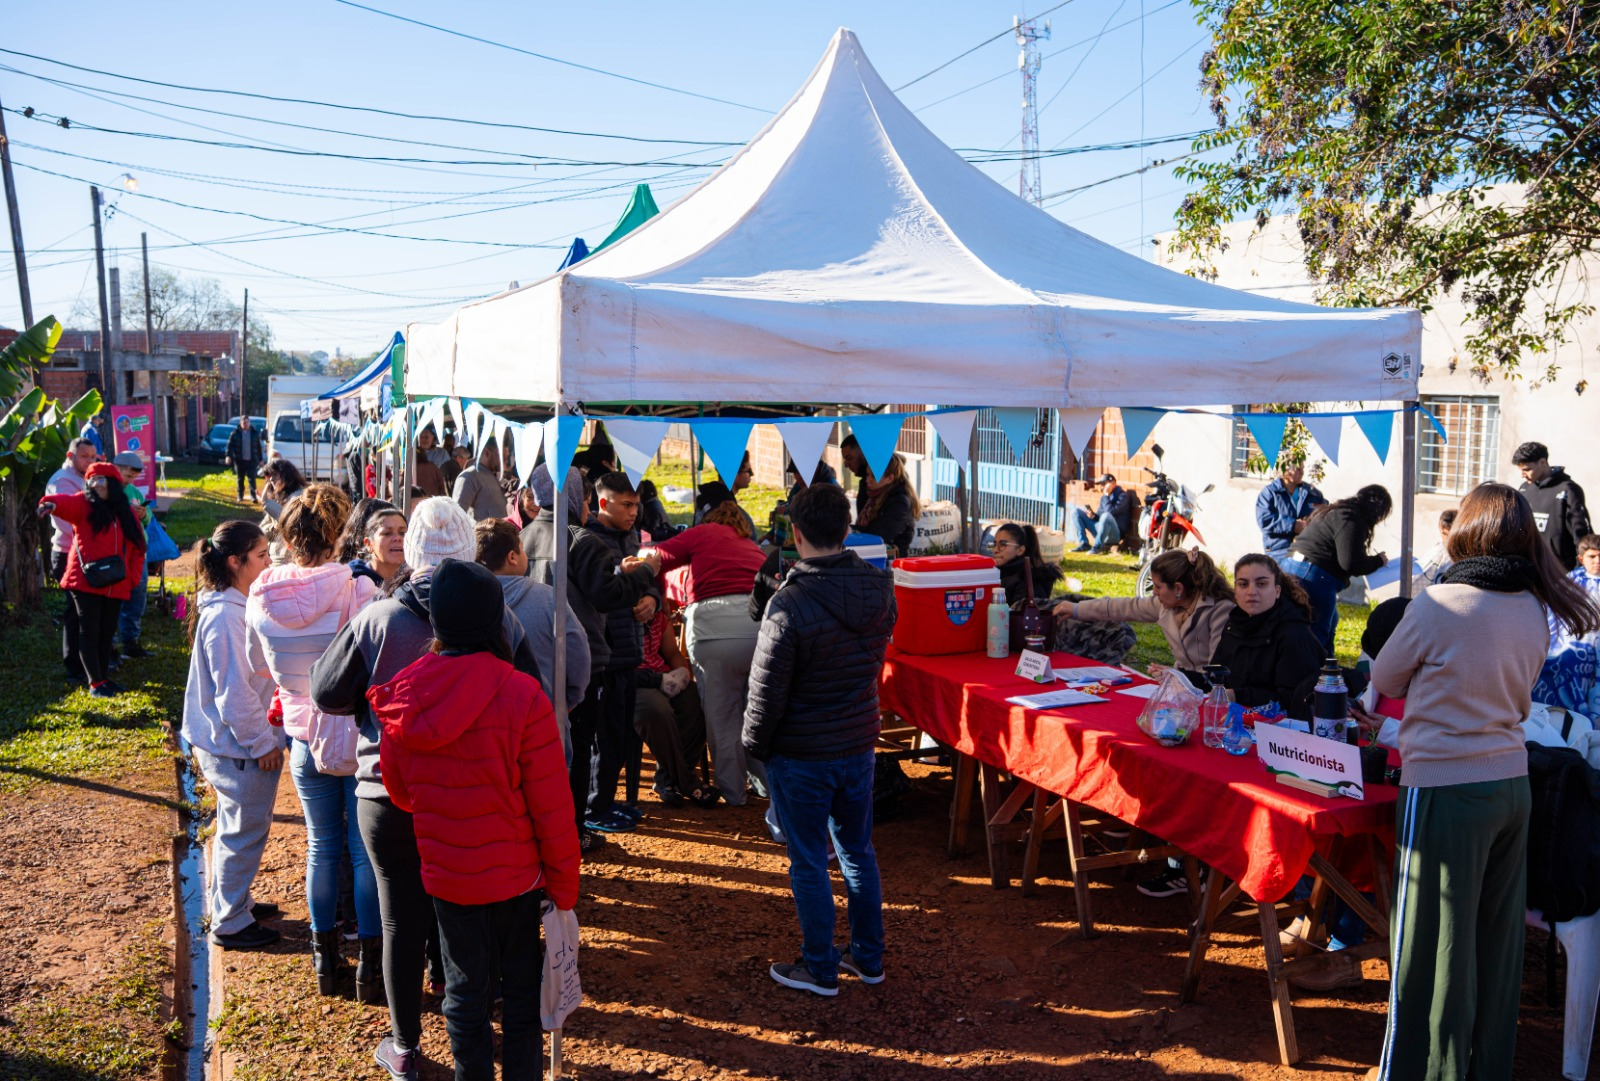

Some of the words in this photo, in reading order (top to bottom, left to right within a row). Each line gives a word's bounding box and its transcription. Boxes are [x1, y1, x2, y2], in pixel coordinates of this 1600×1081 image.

[920, 510, 952, 518] ETERIA
[917, 523, 954, 537] Familia
[1269, 741, 1345, 773] Nutricionista
